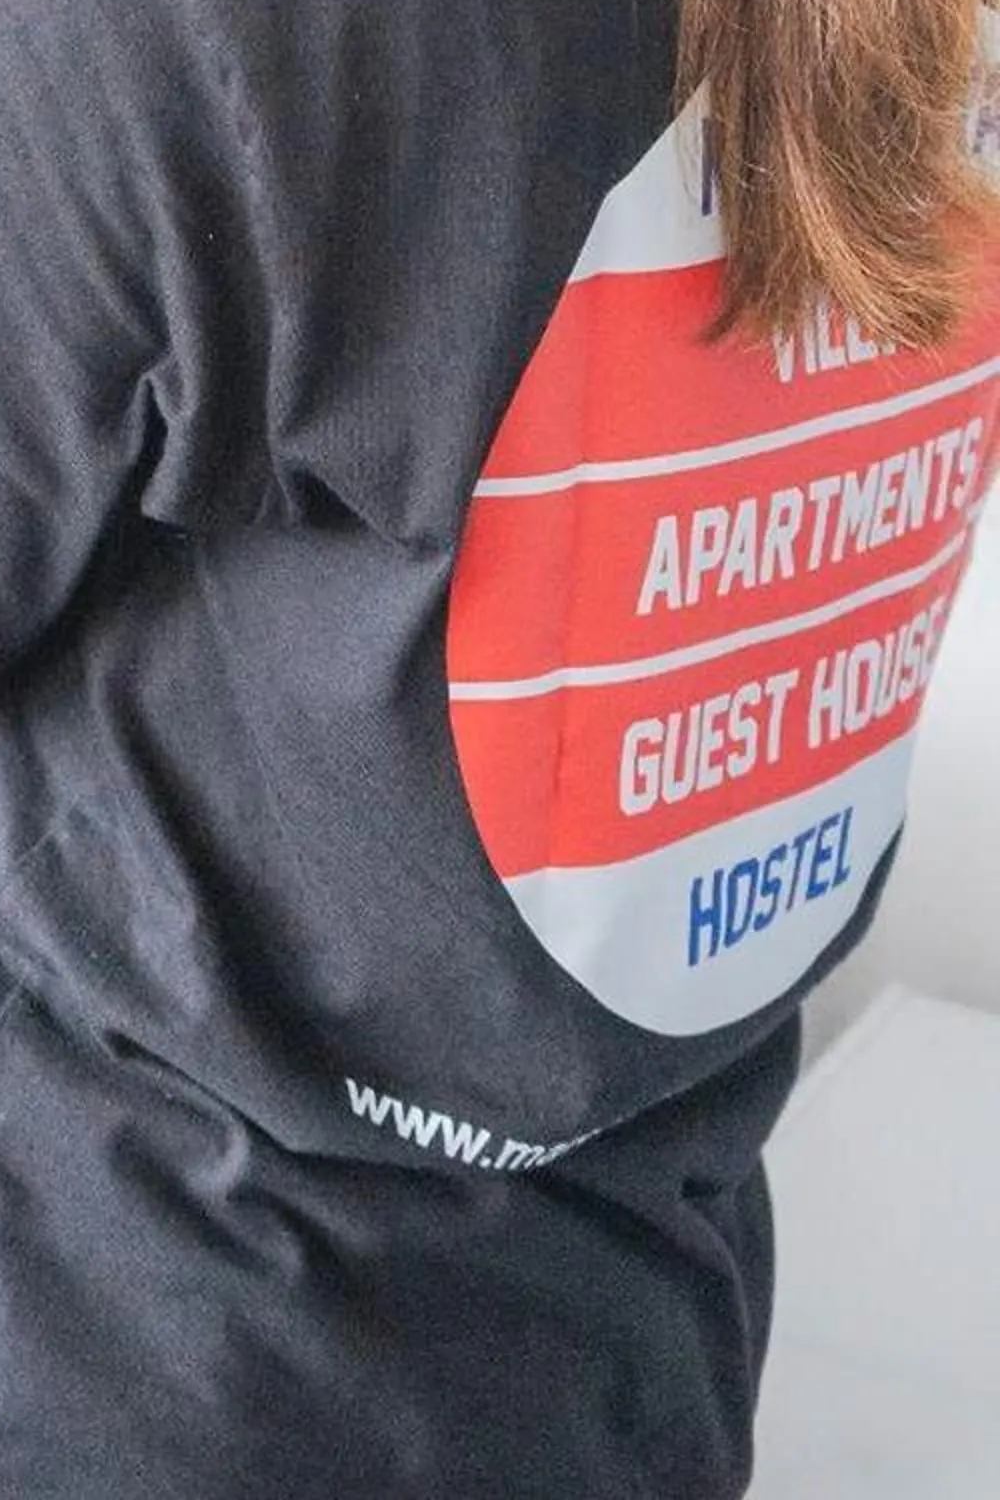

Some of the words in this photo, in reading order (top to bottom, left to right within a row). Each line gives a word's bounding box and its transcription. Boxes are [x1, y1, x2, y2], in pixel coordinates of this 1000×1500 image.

[771, 286, 898, 383] VILL
[635, 416, 984, 617] APARTMENTS
[619, 666, 800, 818] GUEST
[687, 805, 855, 968] HOSTEL
[345, 1076, 568, 1171] www.m
